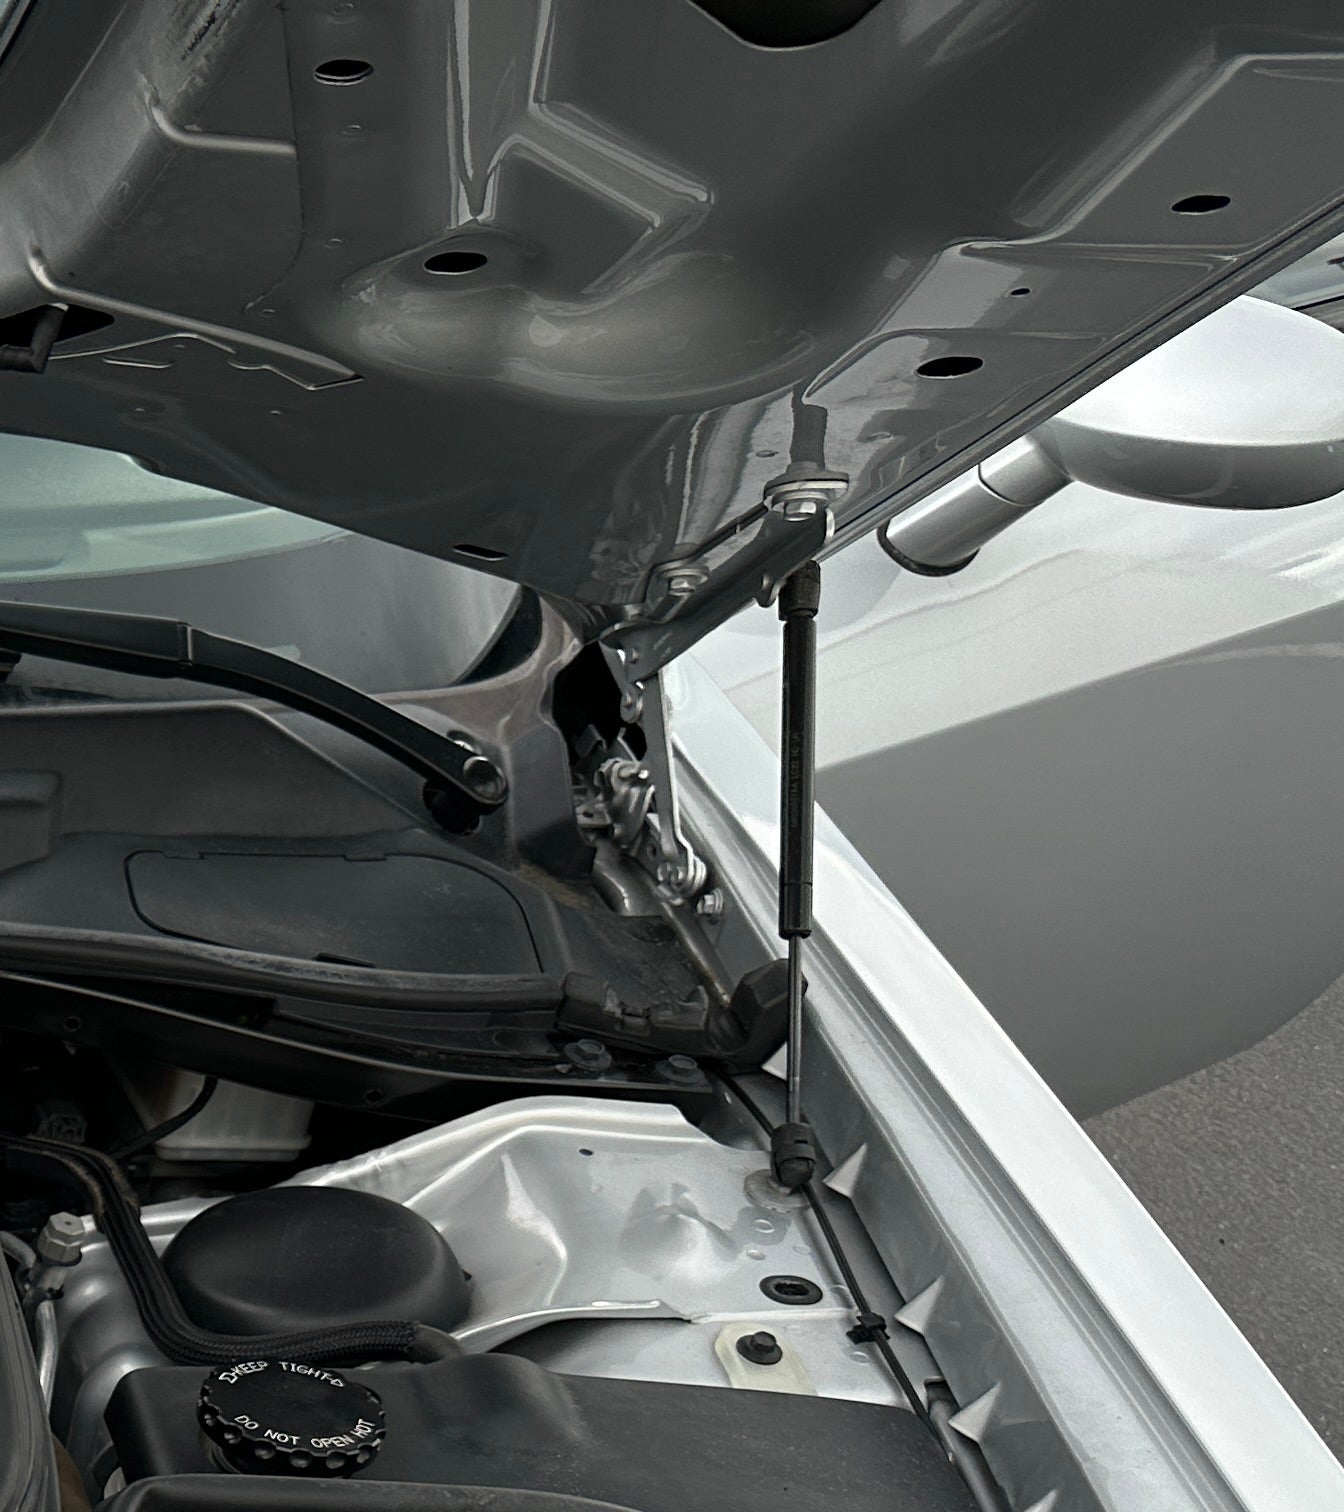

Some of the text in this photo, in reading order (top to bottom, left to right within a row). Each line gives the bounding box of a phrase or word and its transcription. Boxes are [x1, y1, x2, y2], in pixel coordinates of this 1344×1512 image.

[231, 1360, 331, 1381] KEEP TIGHT
[234, 1415, 376, 1449] DO NOT OPEN HOT
